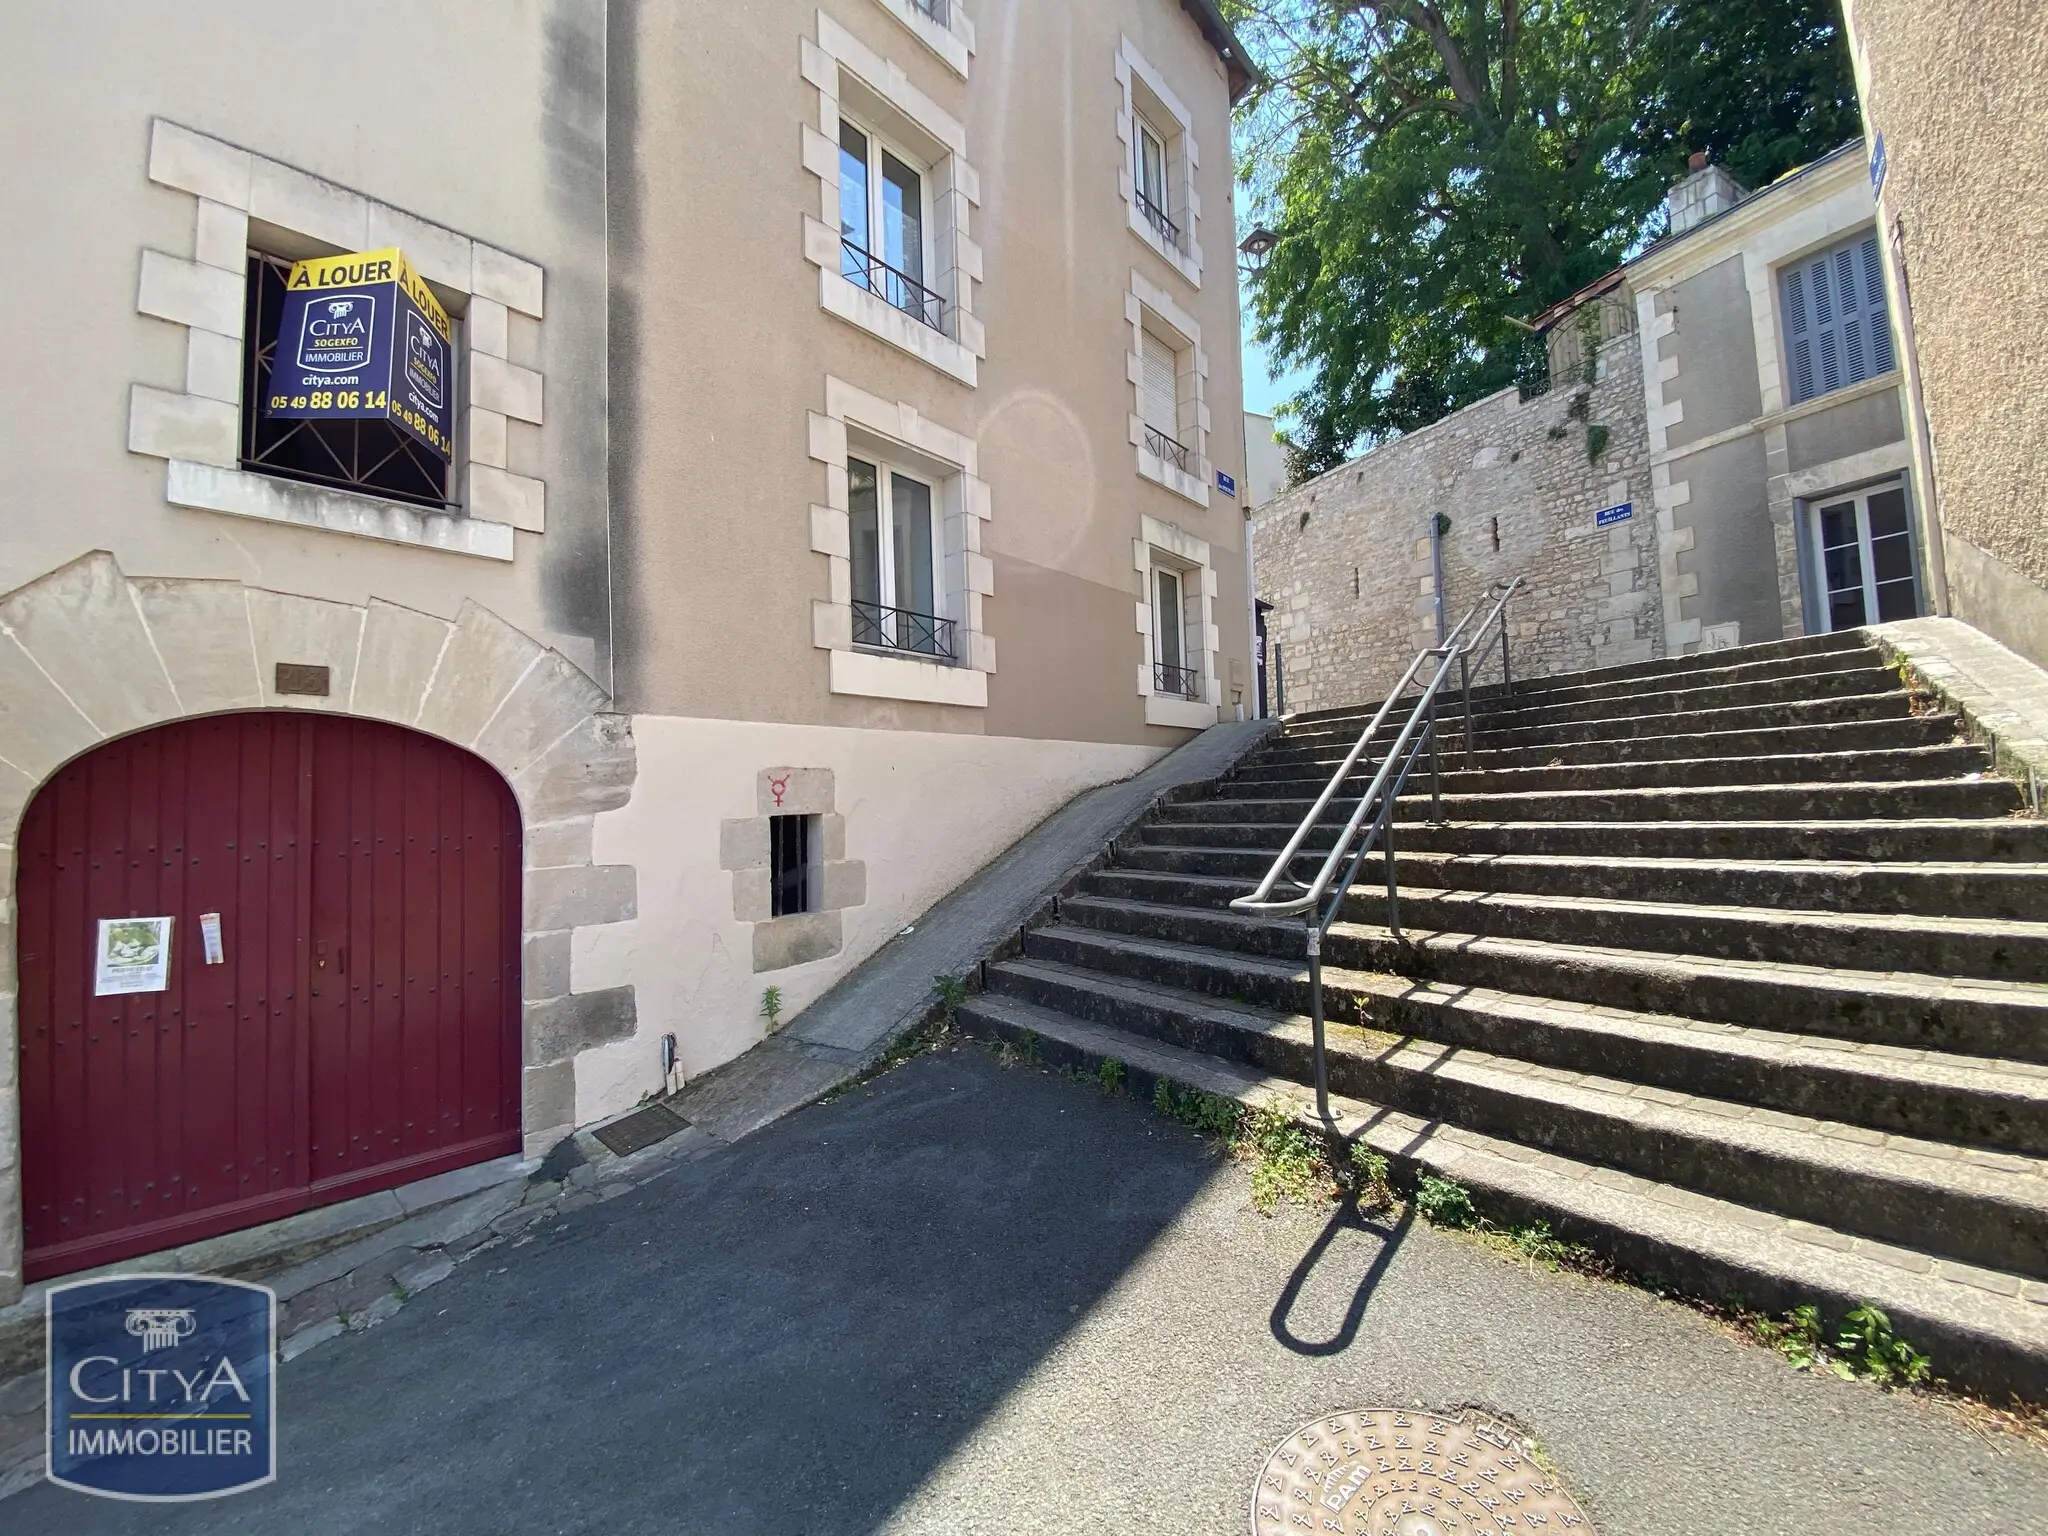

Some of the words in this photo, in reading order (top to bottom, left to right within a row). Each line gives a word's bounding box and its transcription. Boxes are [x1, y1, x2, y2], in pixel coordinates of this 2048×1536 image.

[293, 265, 311, 288] À
[318, 260, 392, 286] LOUER
[400, 260, 409, 292] À
[412, 279, 449, 340] LOUER
[305, 351, 364, 363] IMMOBILIER
[314, 338, 358, 348] SOGEXFO
[302, 374, 359, 388] citya.com
[409, 367, 440, 402] IMMOBILIER
[271, 396, 288, 409] 05
[290, 396, 307, 409] 49
[310, 391, 333, 409] 88
[337, 391, 360, 409] 06
[364, 391, 387, 409] 14
[408, 391, 439, 424] citya.com
[391, 399, 402, 417] 05
[403, 409, 413, 425] 49
[413, 412, 427, 436] 88
[428, 424, 439, 446] 06
[441, 436, 451, 456] 14
